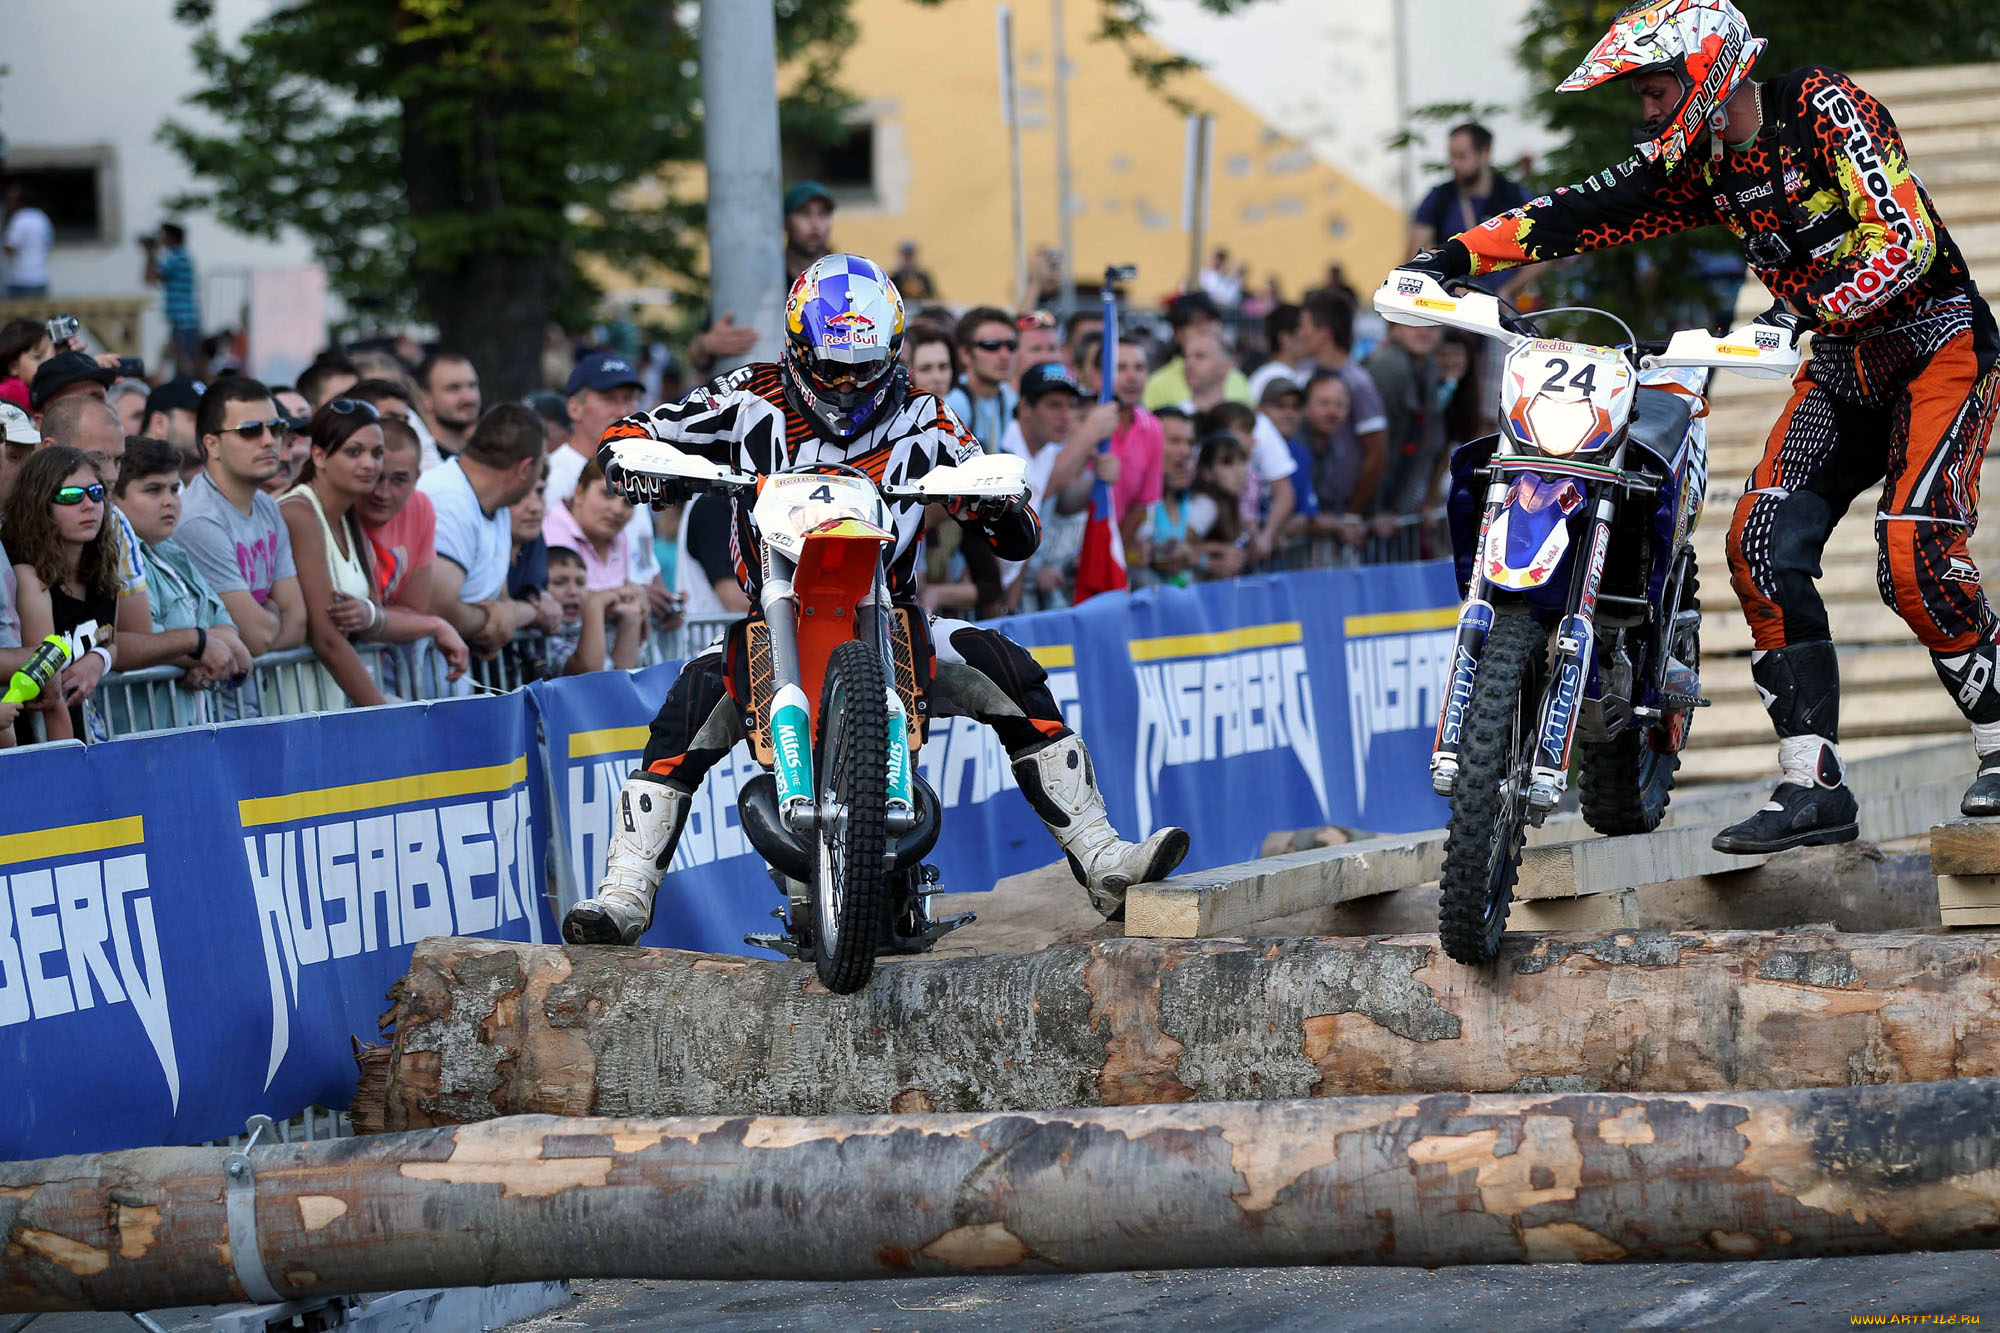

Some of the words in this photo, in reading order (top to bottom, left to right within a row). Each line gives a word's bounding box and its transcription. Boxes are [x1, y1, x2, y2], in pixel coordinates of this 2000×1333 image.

[1684, 23, 1743, 133] SUOMY
[1398, 285, 1420, 294] 2000
[1400, 278, 1422, 288] BAR
[823, 332, 851, 345] Red
[852, 331, 878, 345] Bull
[1756, 331, 1779, 341] BAR
[1756, 339, 1778, 348] 2000
[1535, 340, 1557, 351] Red
[1540, 358, 1597, 397] 24
[809, 485, 835, 503] 4
[767, 532, 794, 548] KTM
[1442, 645, 1478, 745] Mitas
[1542, 663, 1580, 765] Mitas
[777, 724, 802, 769] Mitas
[1134, 646, 1331, 840] HUSABERG
[789, 770, 801, 787] TYRE
[244, 786, 542, 1093] HUSABERG
